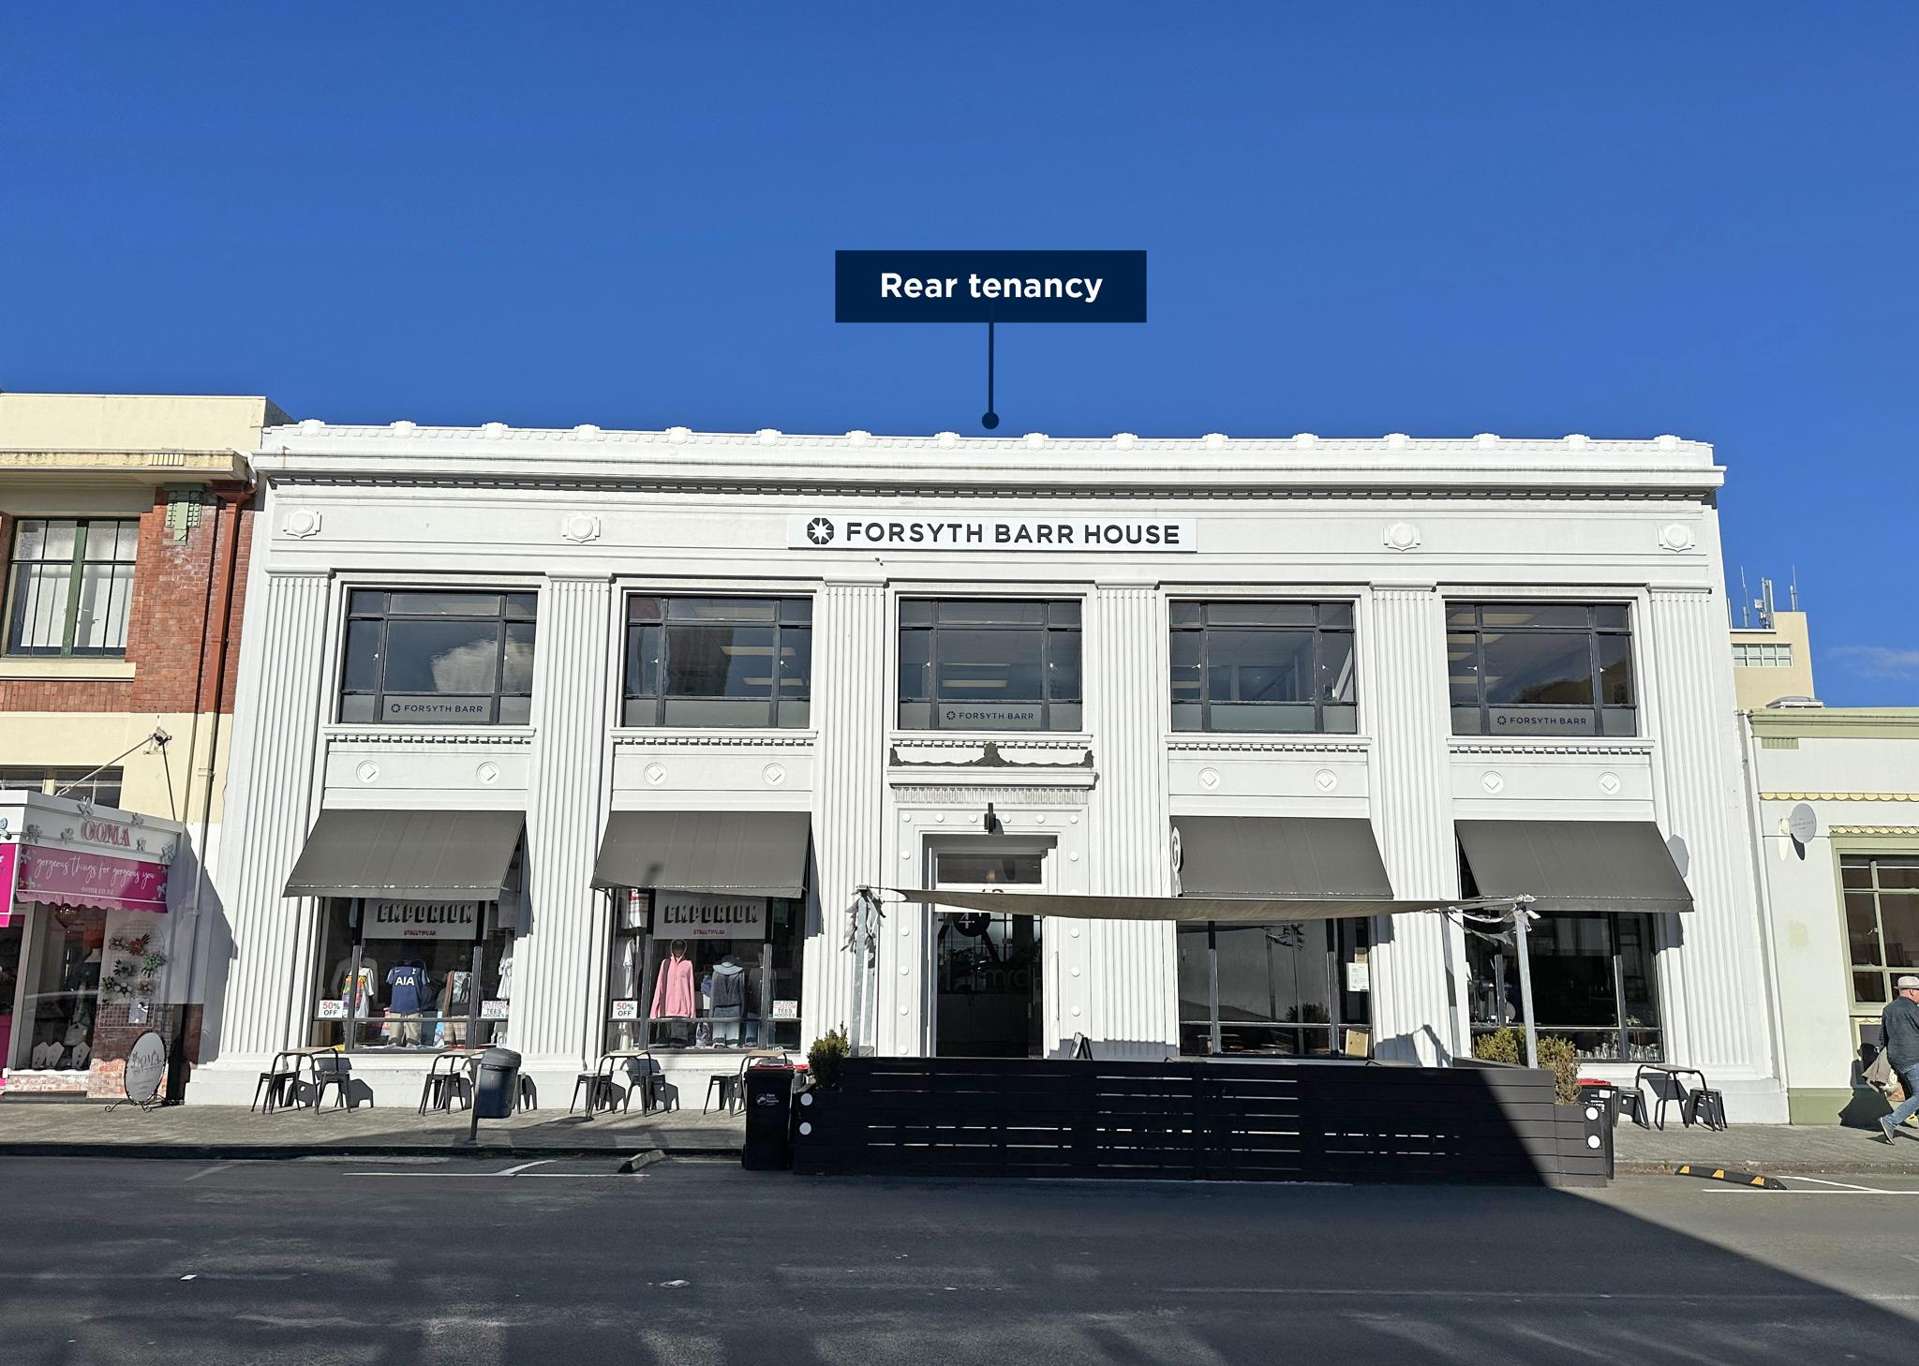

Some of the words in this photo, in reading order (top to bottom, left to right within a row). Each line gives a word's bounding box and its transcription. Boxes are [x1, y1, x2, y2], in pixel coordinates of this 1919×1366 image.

[846, 522, 982, 543] FORSYTH
[995, 524, 1074, 544] BARR
[1084, 525, 1180, 545] HOUSE
[404, 704, 452, 713] FORSYTH
[454, 705, 483, 713] BARR
[958, 712, 1004, 720] FORSYTH
[1510, 716, 1556, 725] FORSYTH
[1559, 717, 1586, 725] BARR
[377, 903, 473, 924] EMPORIUM
[664, 903, 759, 924] EMPORIUM
[395, 976, 415, 986] AIA
[322, 1001, 340, 1010] 50%
[616, 1002, 634, 1010] 50%
